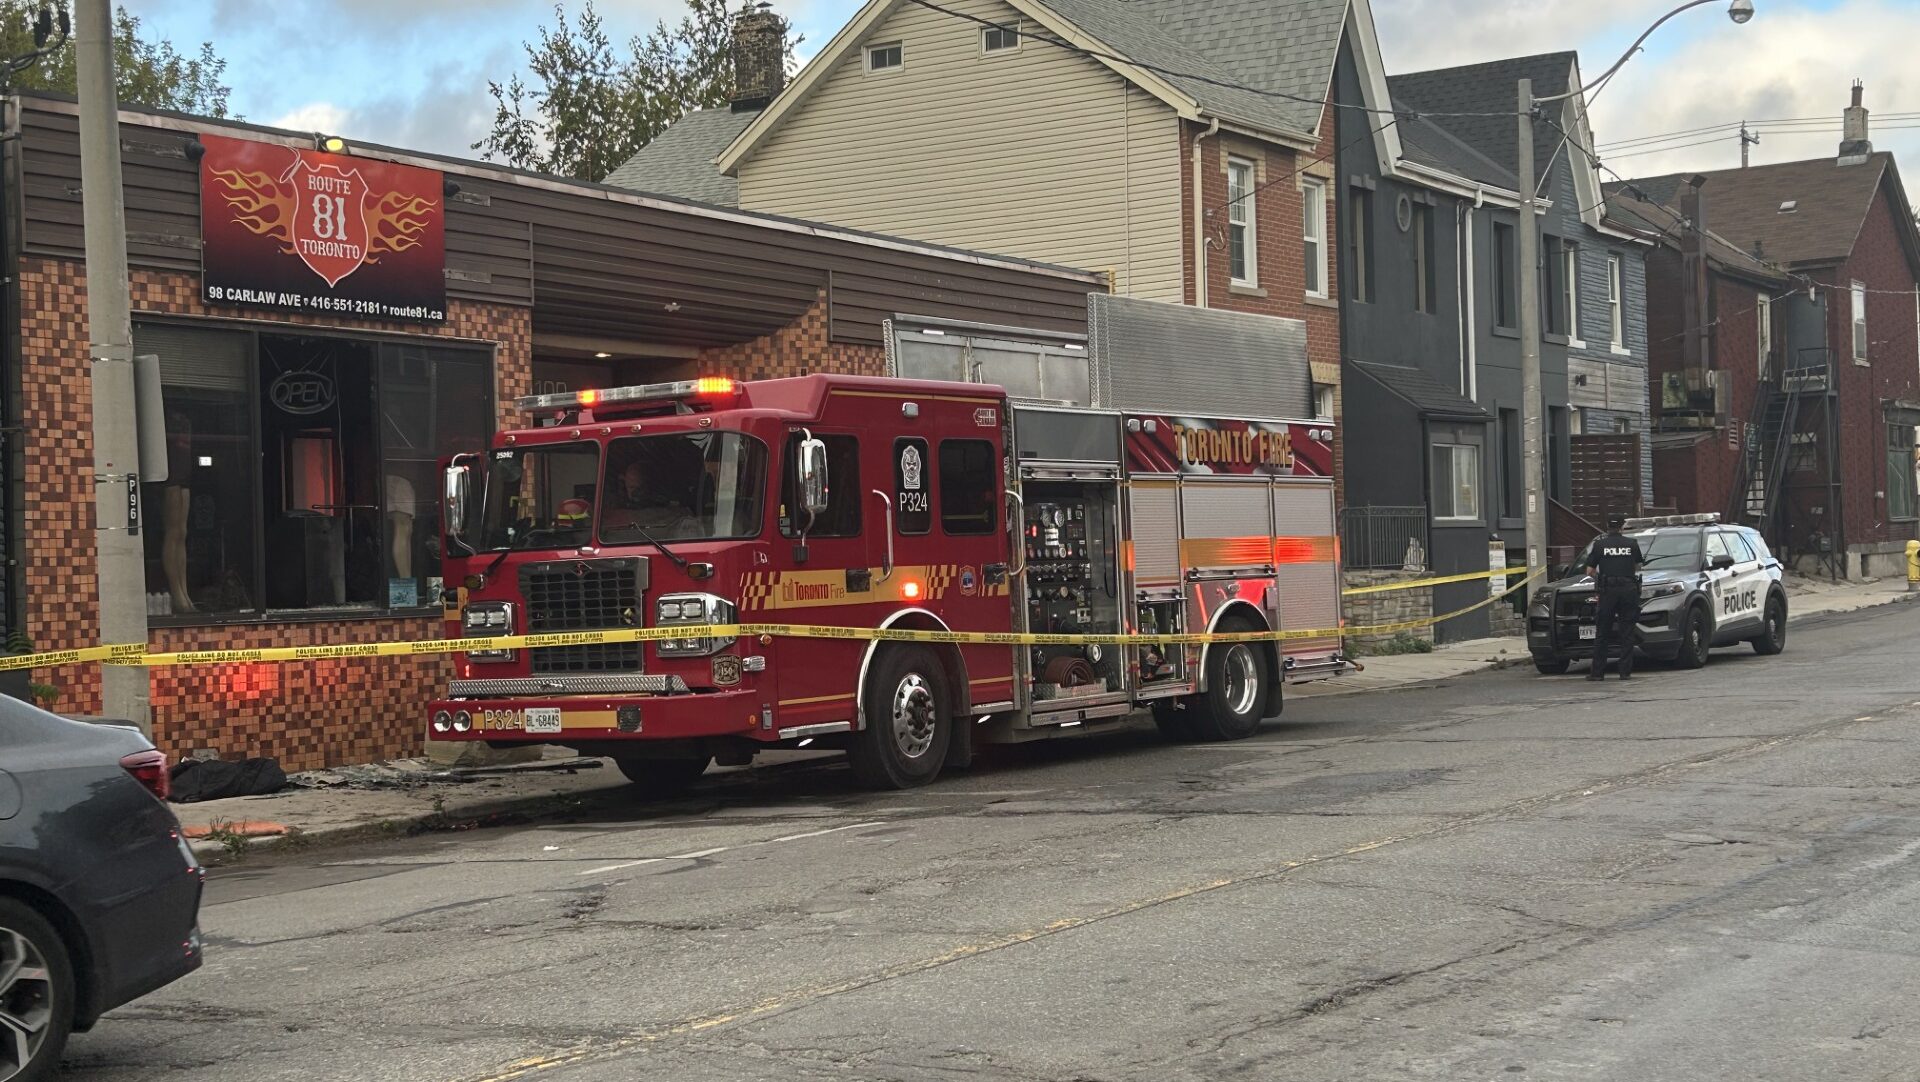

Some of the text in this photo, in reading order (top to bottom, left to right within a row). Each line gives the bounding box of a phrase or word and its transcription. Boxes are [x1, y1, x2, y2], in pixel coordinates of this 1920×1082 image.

[308, 174, 351, 195] ROUTE
[312, 193, 348, 241] 81
[300, 238, 360, 260] TORONTO
[209, 286, 223, 299] 98
[226, 288, 276, 304] CARLAW
[279, 293, 301, 306] AVE
[390, 305, 443, 320] route81.ca
[274, 381, 334, 404] OPEN
[1173, 423, 1295, 469] TORONTO FIRE
[899, 492, 928, 512] P324
[1603, 547, 1632, 556] POLICE
[793, 581, 845, 601] TORONTO Fire
[1723, 590, 1757, 615] POLICE
[484, 709, 522, 731] P324
[526, 714, 535, 727] BL
